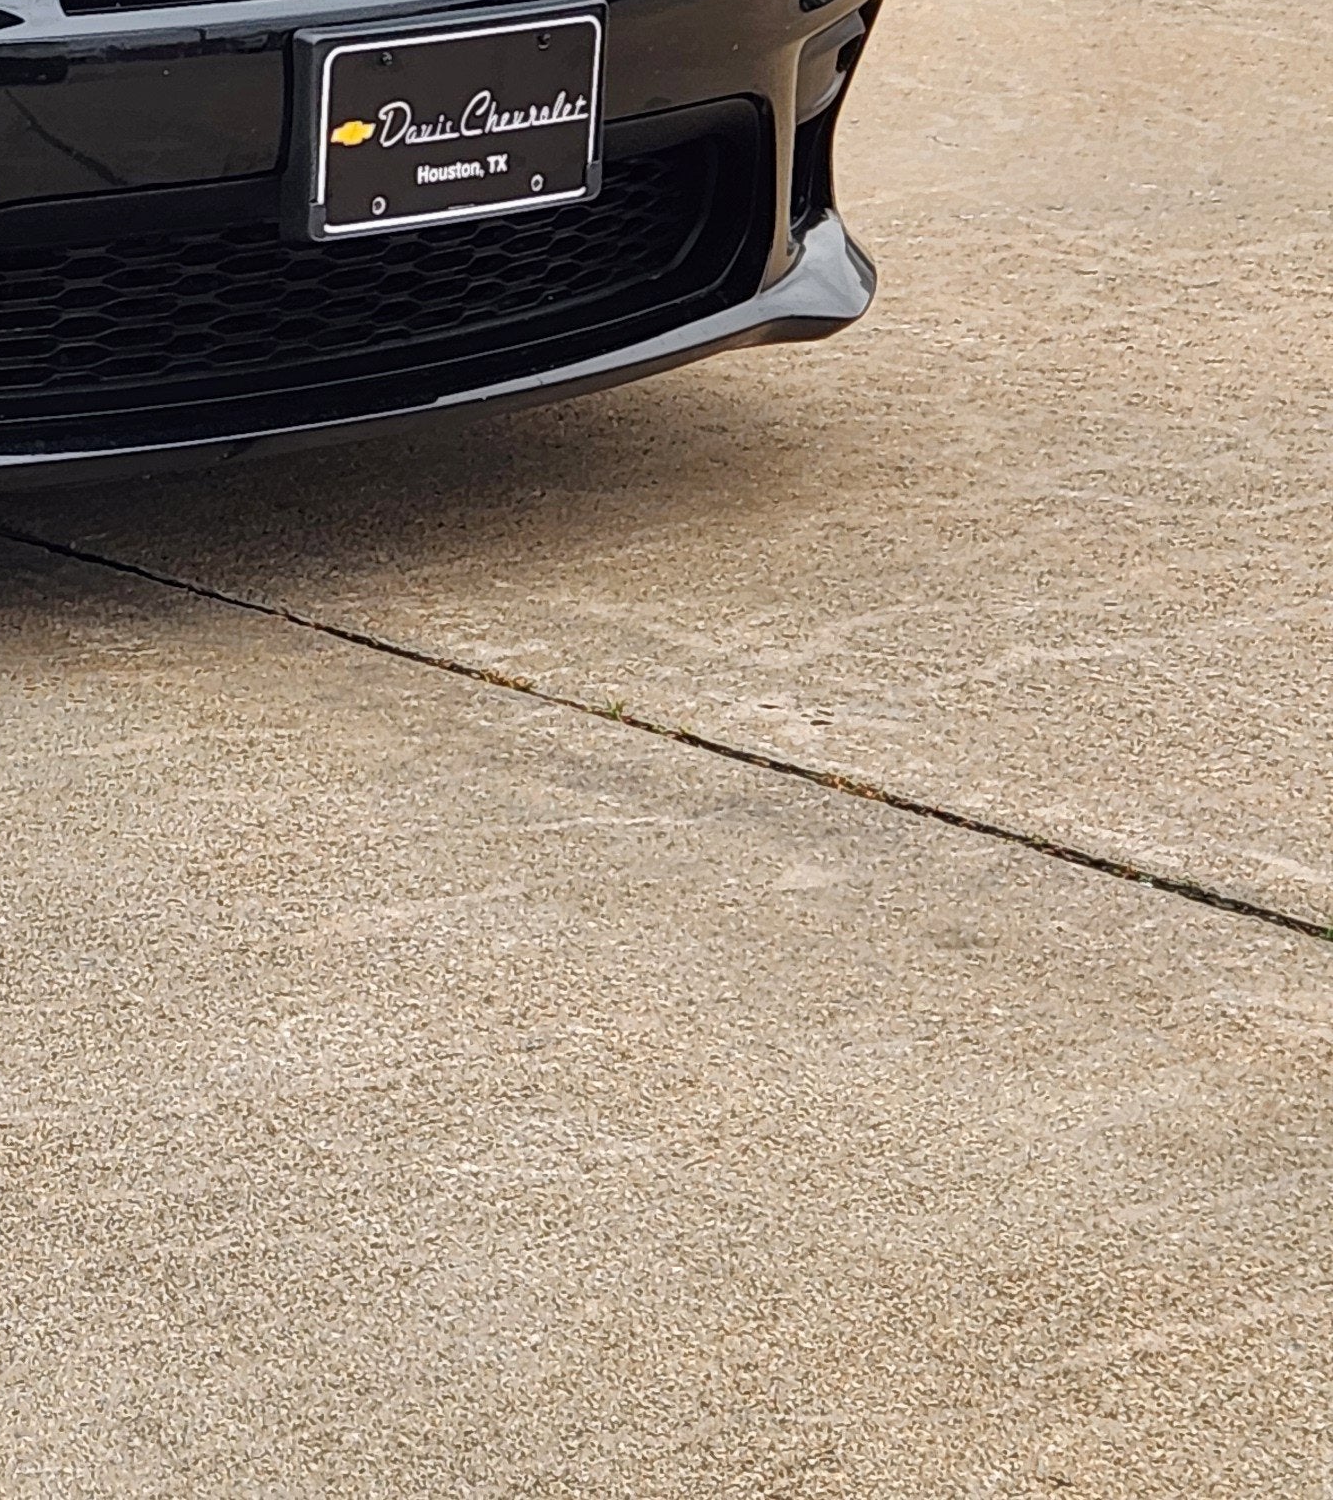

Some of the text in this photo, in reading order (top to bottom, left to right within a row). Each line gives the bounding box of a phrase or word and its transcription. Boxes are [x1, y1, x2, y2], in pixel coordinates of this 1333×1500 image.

[379, 89, 589, 148] Davis Chevrolet
[417, 153, 509, 185] Houston, TX
